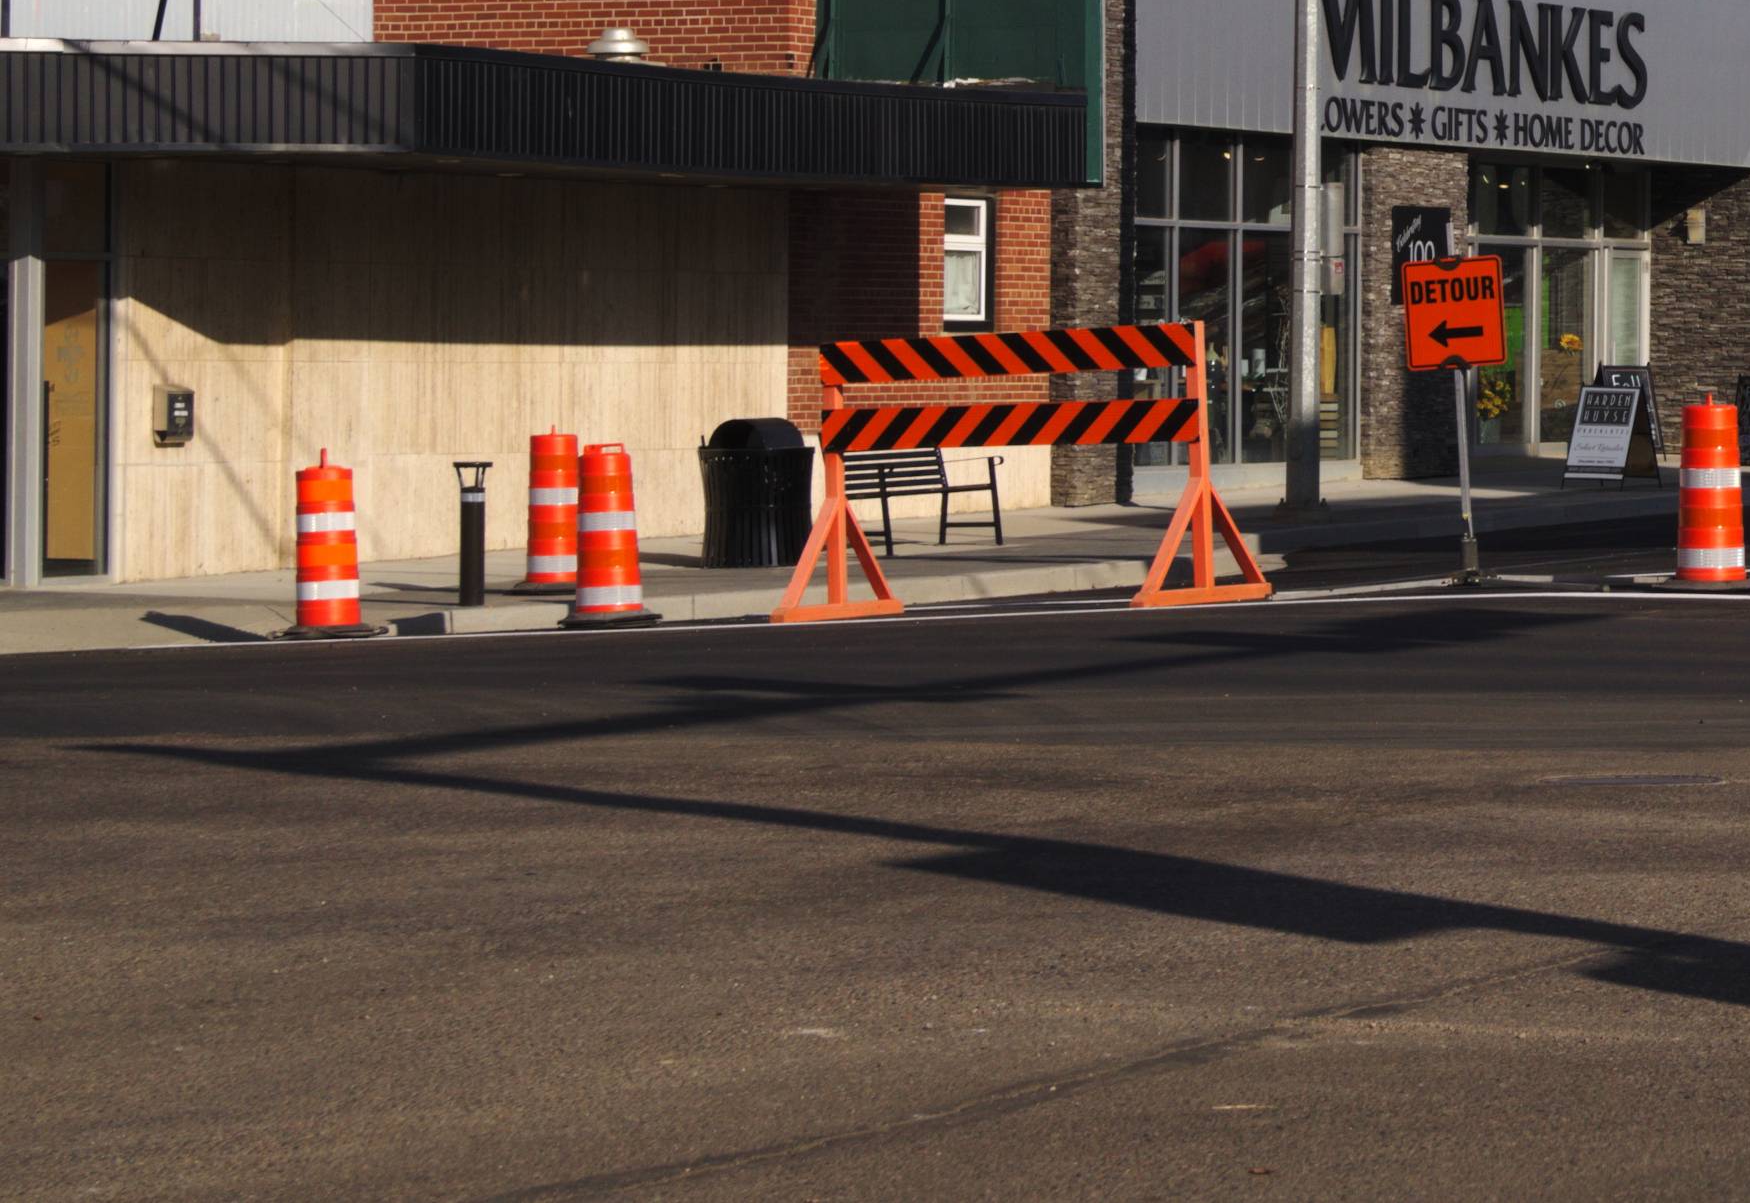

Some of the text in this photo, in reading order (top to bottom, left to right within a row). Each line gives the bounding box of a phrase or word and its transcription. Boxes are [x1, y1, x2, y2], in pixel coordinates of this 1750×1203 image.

[1320, 97, 1645, 156] OWERS GIFTS HOME DECOR
[1410, 276, 1495, 305] DETOUR
[1586, 394, 1632, 407] HARDEN
[1583, 410, 1629, 423] HUYSE
